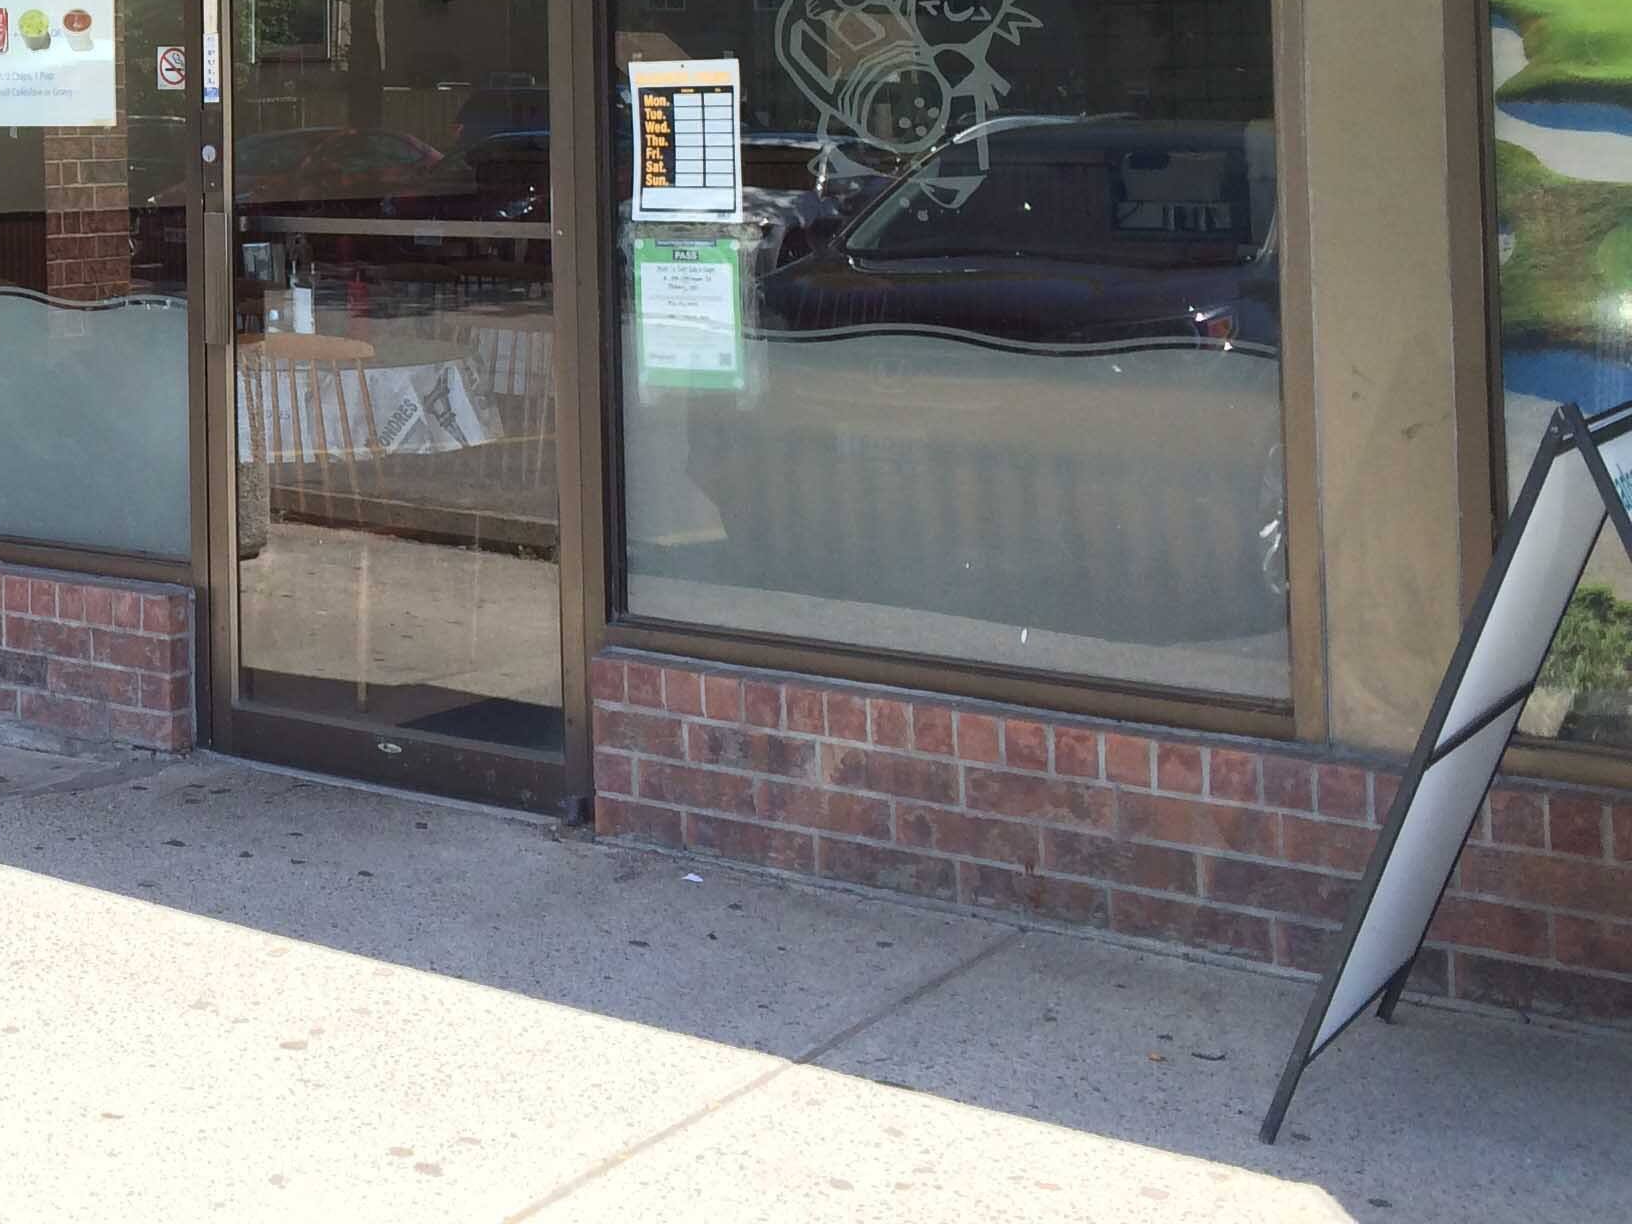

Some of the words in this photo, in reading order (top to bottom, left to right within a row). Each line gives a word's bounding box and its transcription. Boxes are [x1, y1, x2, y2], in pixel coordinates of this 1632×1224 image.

[643, 94, 670, 107] Mon.
[644, 108, 666, 120] Tue.
[644, 121, 671, 134] Wed.
[645, 134, 669, 147] Thu.
[645, 147, 663, 160] Fri.
[645, 160, 666, 173] Sat.
[645, 173, 669, 186] Sun.
[674, 250, 698, 260] PASS
[366, 397, 418, 449] ONDRES
